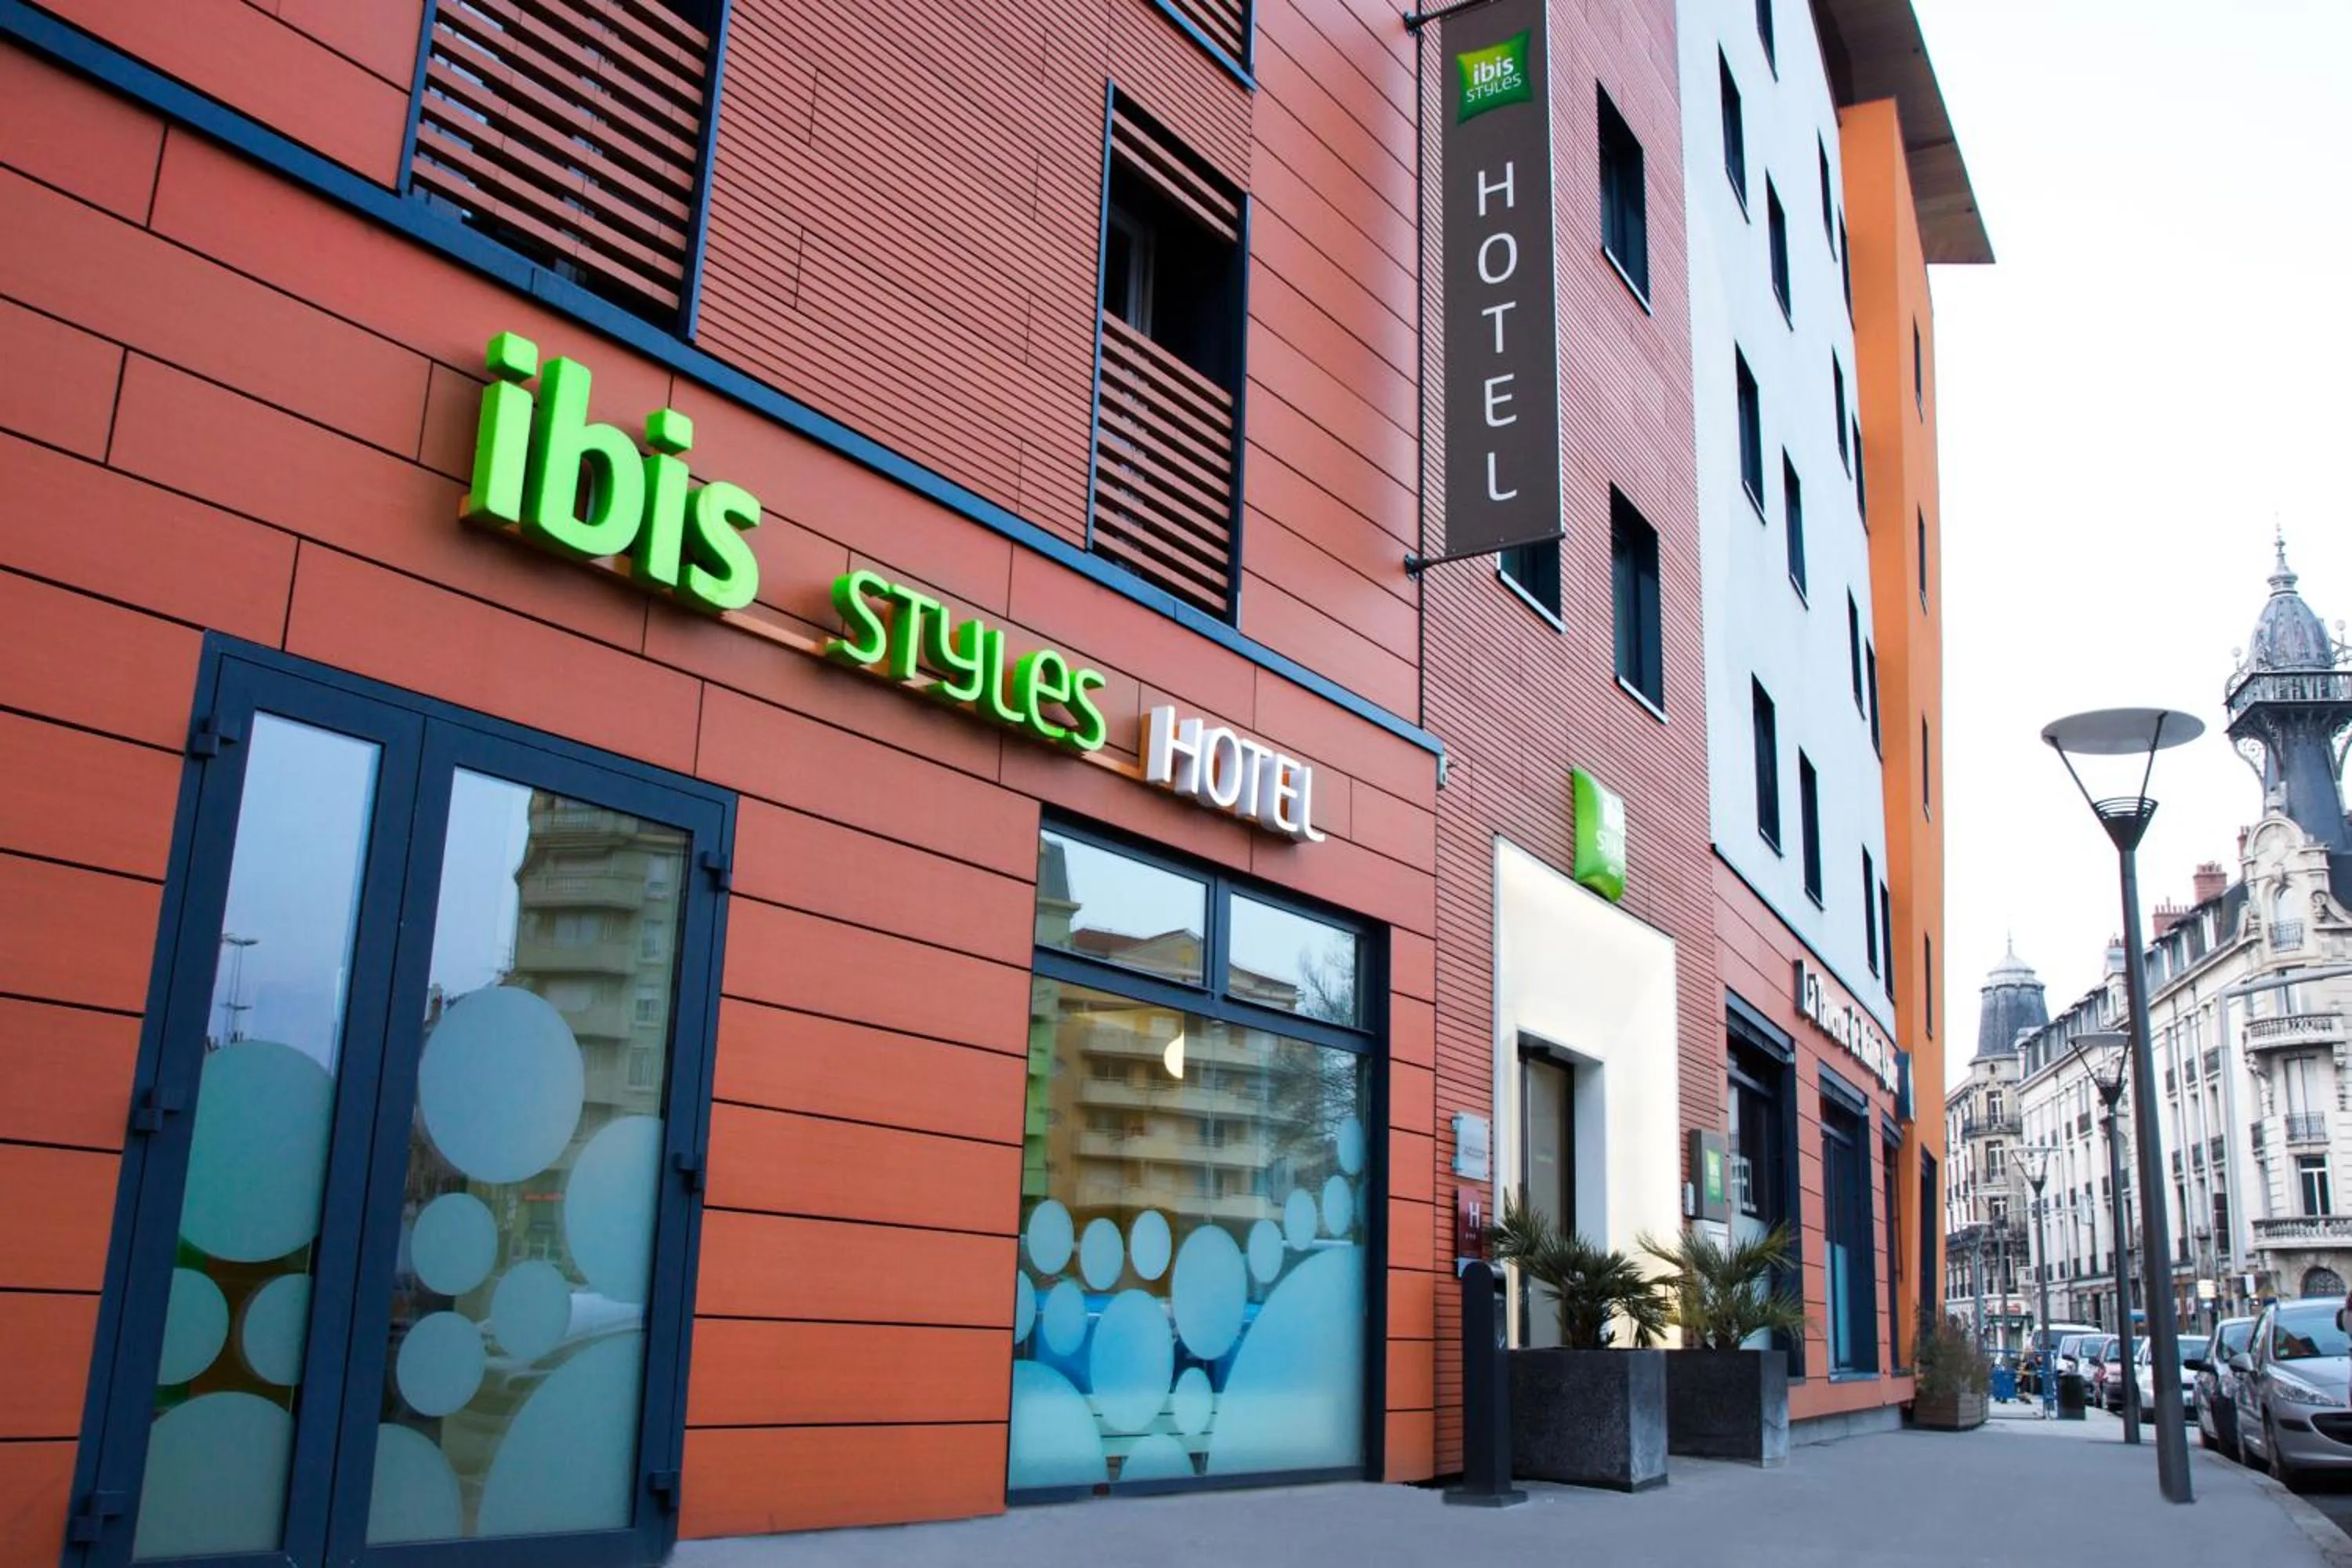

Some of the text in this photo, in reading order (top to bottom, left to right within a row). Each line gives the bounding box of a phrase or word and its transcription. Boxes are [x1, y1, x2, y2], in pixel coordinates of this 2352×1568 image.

[1473, 56, 1515, 85] ibis
[1477, 162, 1519, 503] HOTEL
[470, 331, 762, 611] ibis
[1145, 705, 1326, 843] HOTEL
[1468, 1201, 1480, 1229] H
